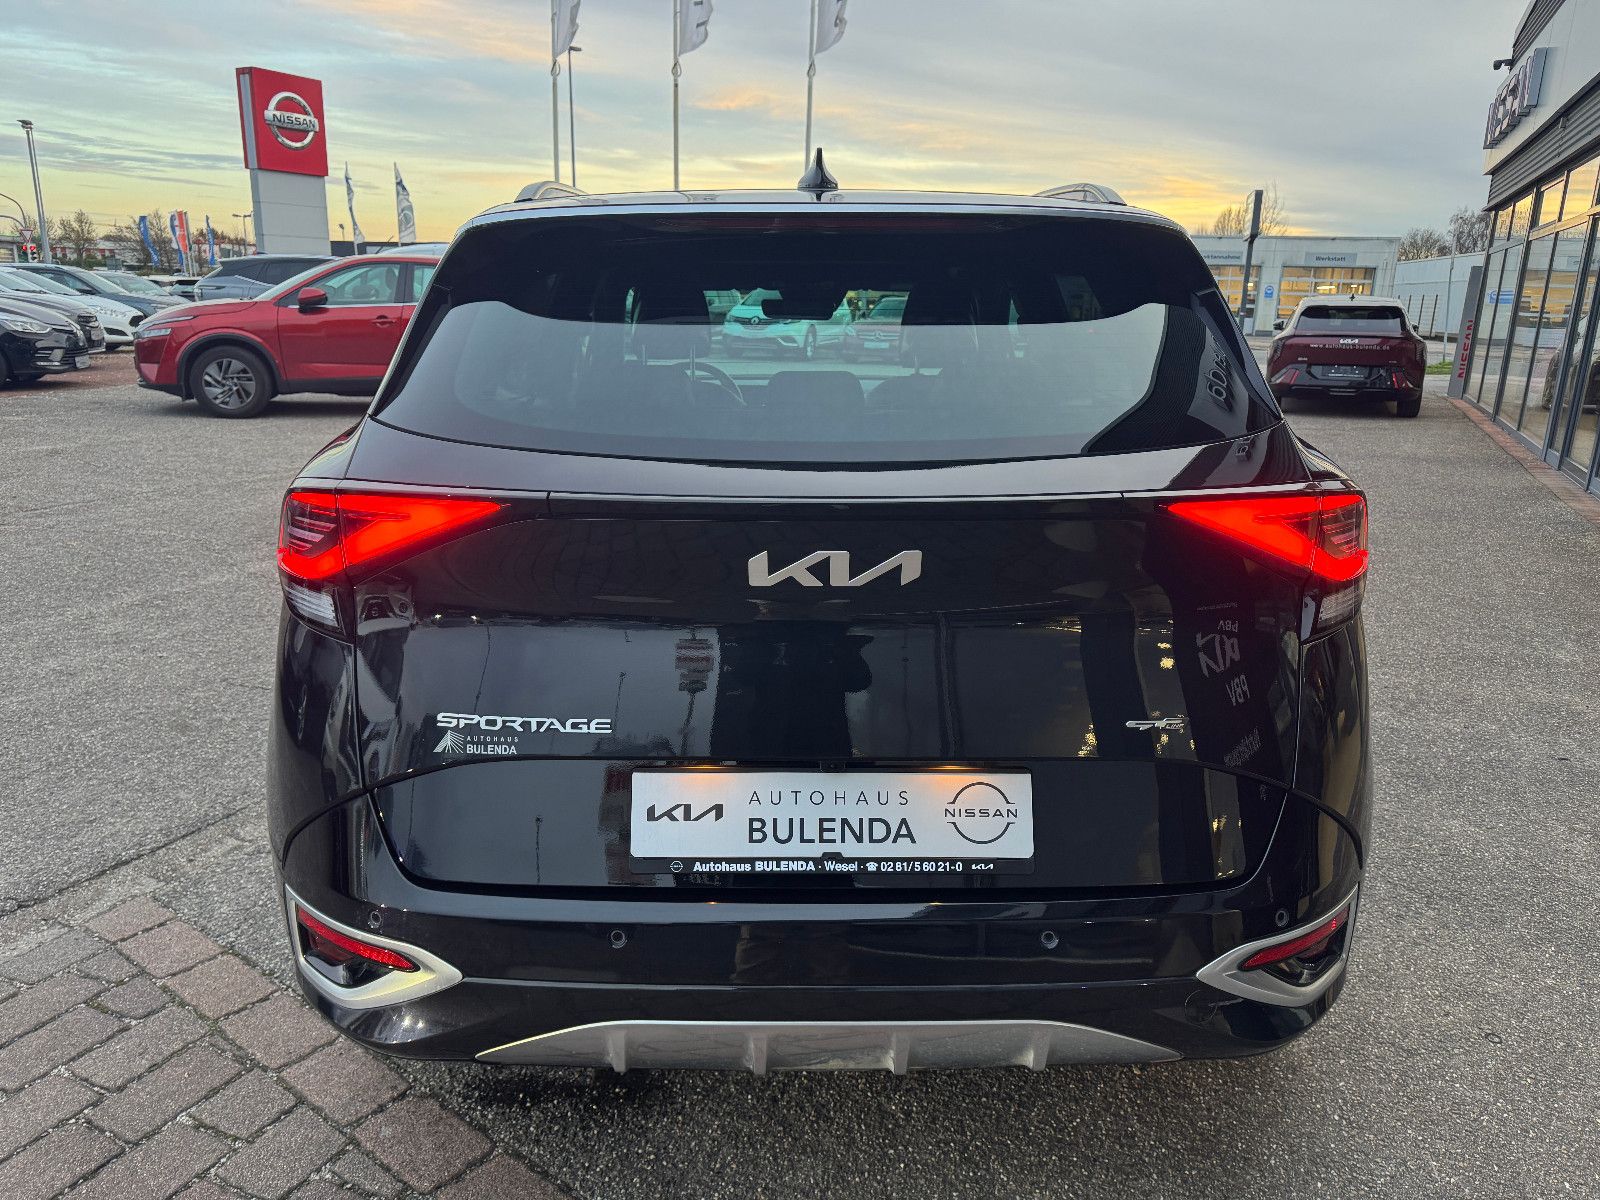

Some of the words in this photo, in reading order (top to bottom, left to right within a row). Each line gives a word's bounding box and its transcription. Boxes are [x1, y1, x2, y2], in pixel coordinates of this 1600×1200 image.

[272, 113, 316, 129] NISSAN
[748, 550, 923, 587] KIA
[436, 712, 613, 734] SPORTAGE
[466, 735, 519, 743] AUTOHAUS
[466, 744, 518, 755] BULENDA
[748, 790, 909, 805] AUTOHAUS
[646, 803, 724, 822] KIA
[944, 808, 1018, 818] NISSAN
[748, 817, 917, 844] BULENDA
[693, 861, 752, 872] Autohaus
[754, 860, 816, 872] BULENDA
[823, 861, 858, 872] Wesel
[971, 863, 994, 871] KIA
